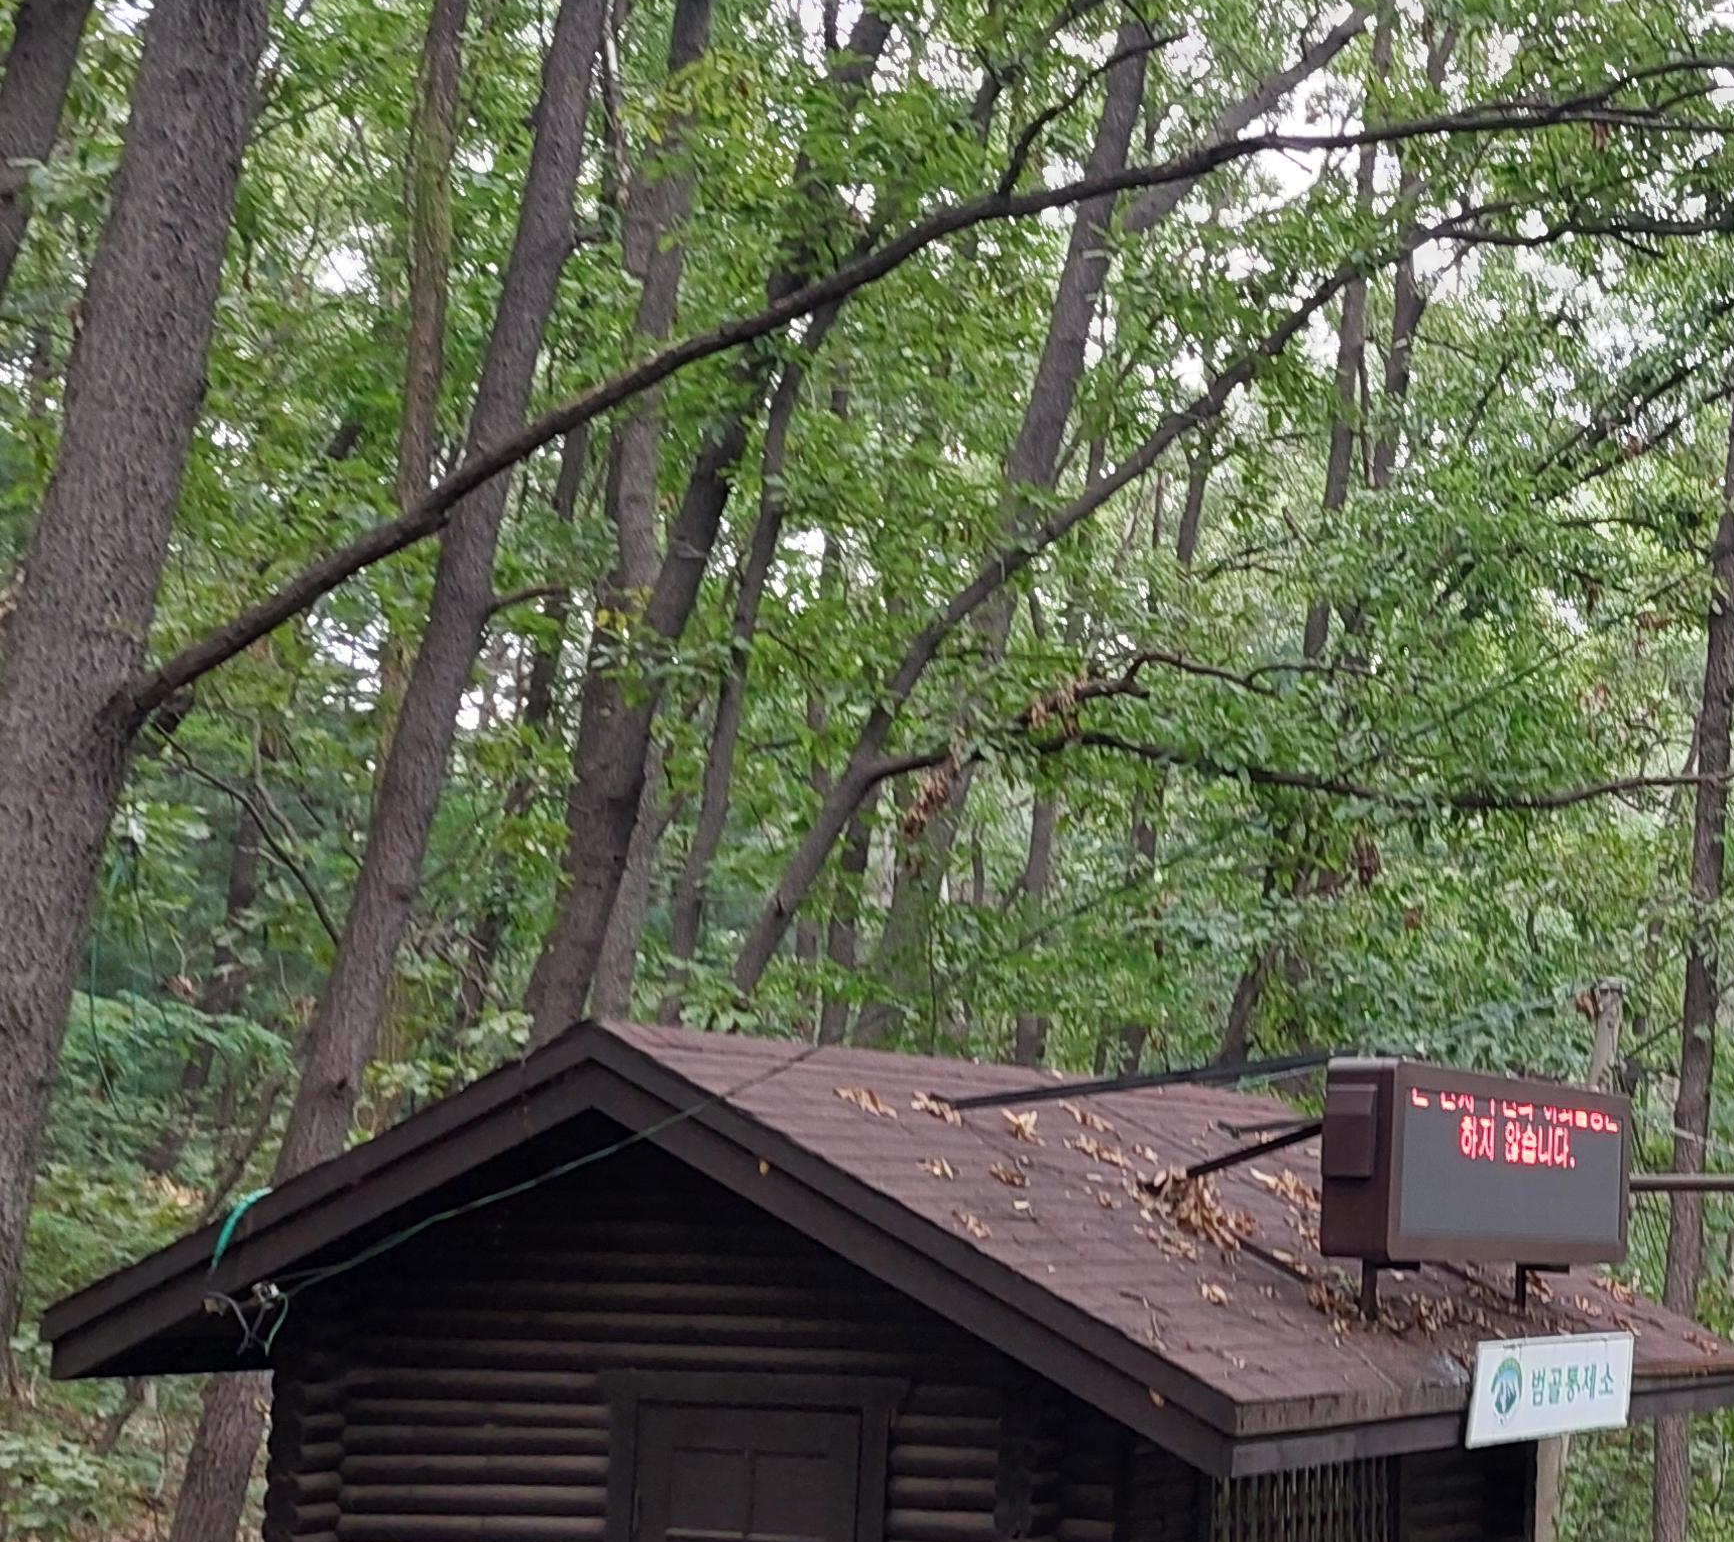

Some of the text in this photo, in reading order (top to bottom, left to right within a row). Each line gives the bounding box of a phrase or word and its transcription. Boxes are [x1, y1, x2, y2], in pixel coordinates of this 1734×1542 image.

[1459, 1115, 1576, 1169] 하지 않습니다.
[1531, 1362, 1614, 1407] 범골통제소
